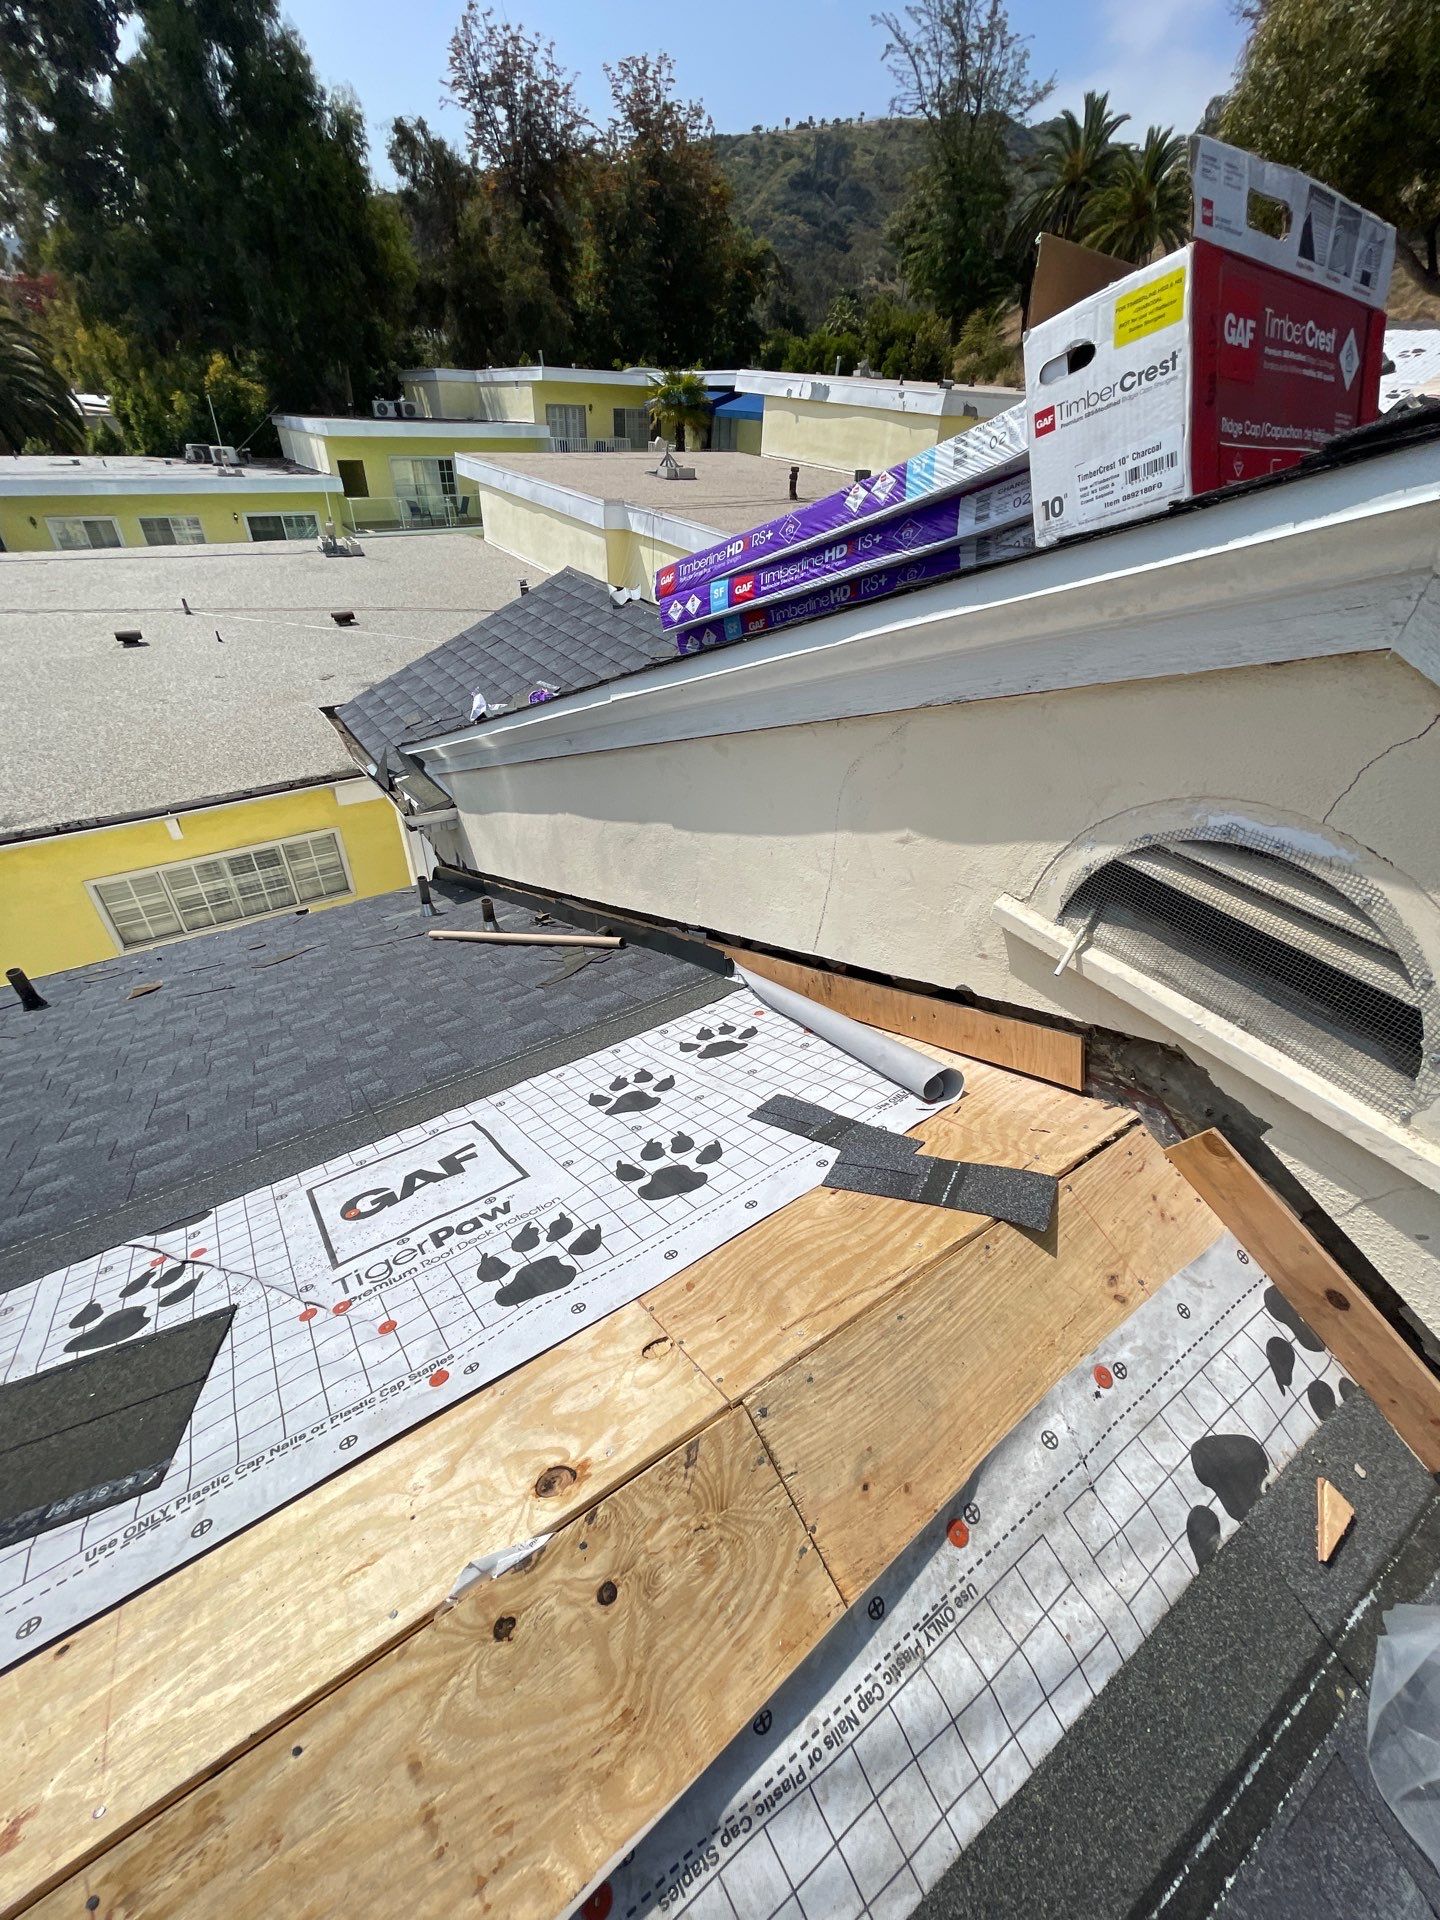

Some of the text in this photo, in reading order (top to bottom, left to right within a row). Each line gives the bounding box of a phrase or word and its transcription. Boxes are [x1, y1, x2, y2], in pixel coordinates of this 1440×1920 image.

[1224, 307, 1337, 354] GAF TimberCrest
[1056, 349, 1179, 421] TimberCrest
[1036, 413, 1055, 431] GAF
[1221, 416, 1244, 438] Ridge
[1077, 461, 1116, 483] TimberCrest
[1131, 441, 1162, 461] Charcoal
[1104, 498, 1120, 509] Item
[660, 572, 675, 586] GAF
[751, 530, 774, 548] RS+
[713, 586, 725, 599] SF
[734, 581, 753, 595] GAF
[748, 618, 766, 631] GAF
[340, 1142, 479, 1222] GAF
[351, 1196, 561, 1303] Premium Roof Deck Protection
[84, 1352, 455, 1562] Use ONLY Plastic Cap Nails or Plastic Cap Staples
[656, 1582, 979, 1912] Use ONLY Plastic Cap Nails or Plastic Cap Staples
